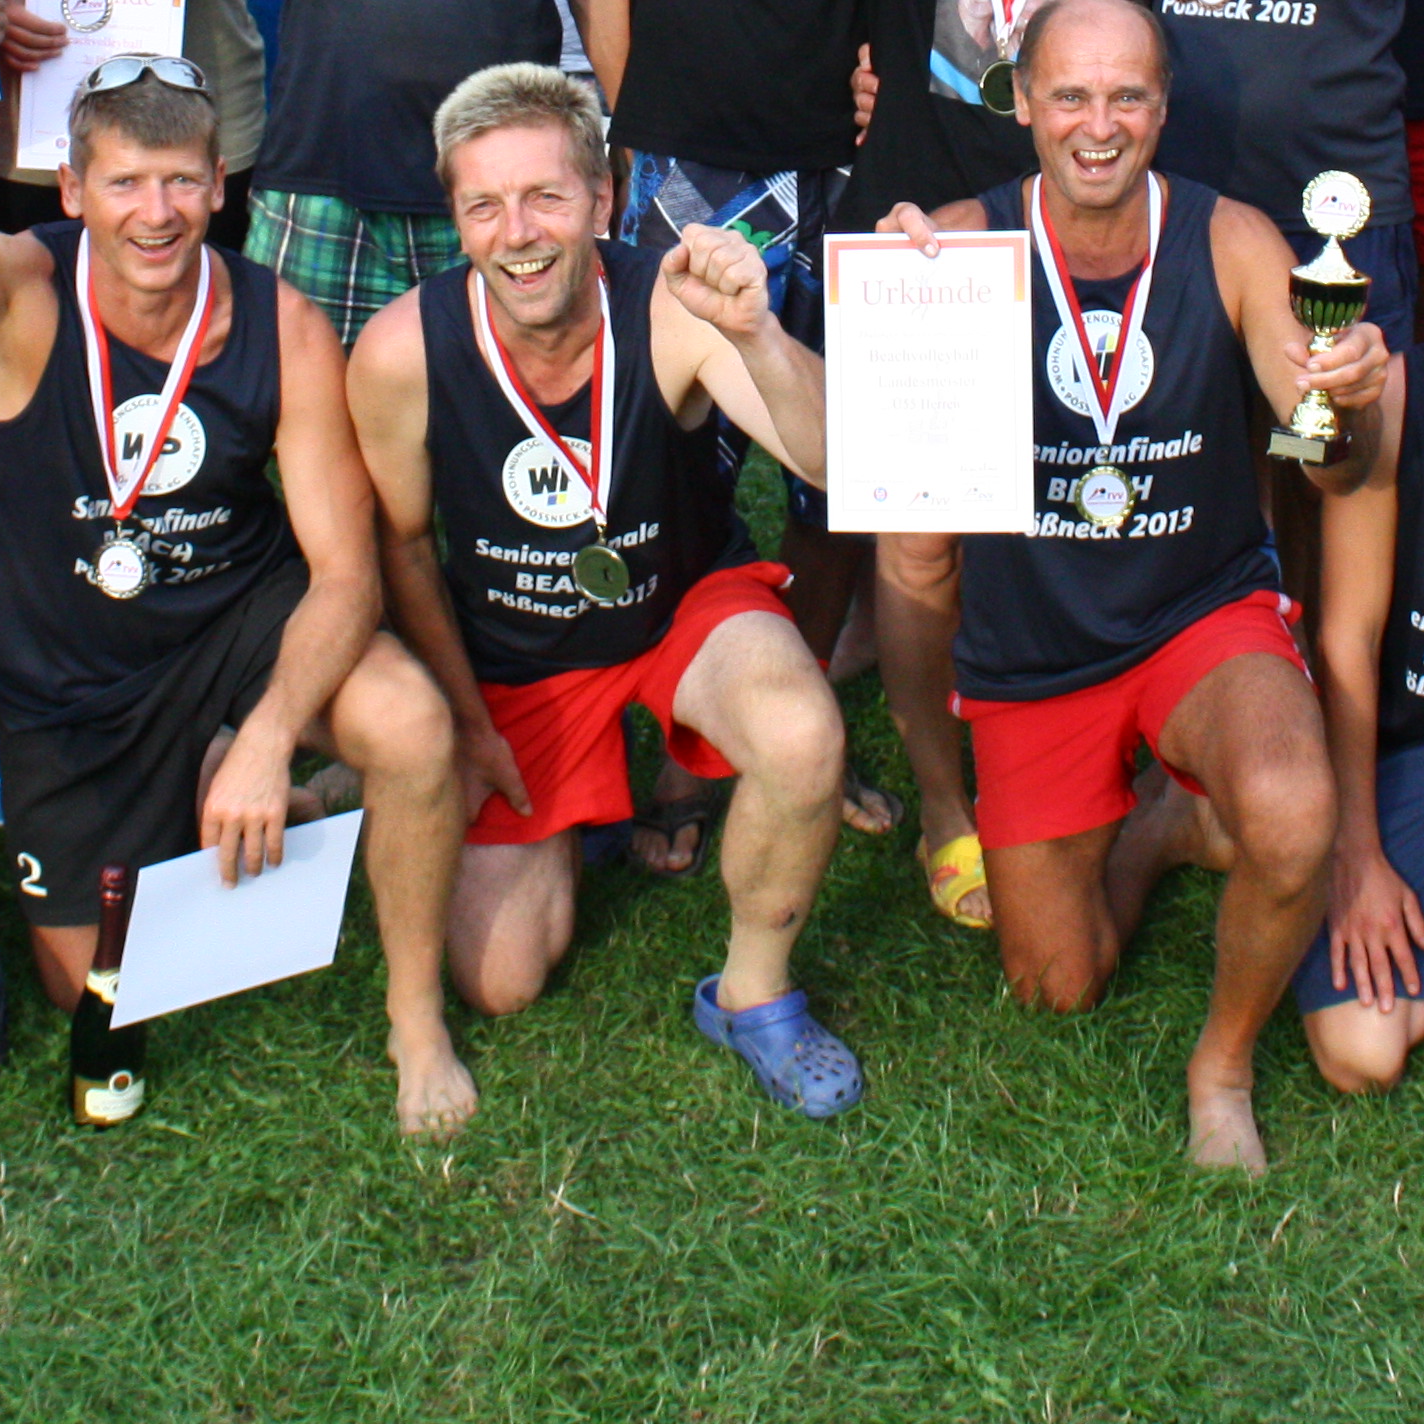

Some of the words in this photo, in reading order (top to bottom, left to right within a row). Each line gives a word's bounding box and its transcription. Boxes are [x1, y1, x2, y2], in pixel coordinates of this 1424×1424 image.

[862, 276, 992, 305] Urkunde
[869, 348, 980, 365] Beachvolleyball
[1034, 430, 1203, 465] eniorenfinale
[522, 506, 582, 523] PÖSSNECK
[1025, 512, 1122, 539] ößneck
[1128, 506, 1195, 538] 2013
[475, 522, 660, 567] Seniorenale
[515, 571, 576, 594] BEA
[16, 852, 47, 897] 2
